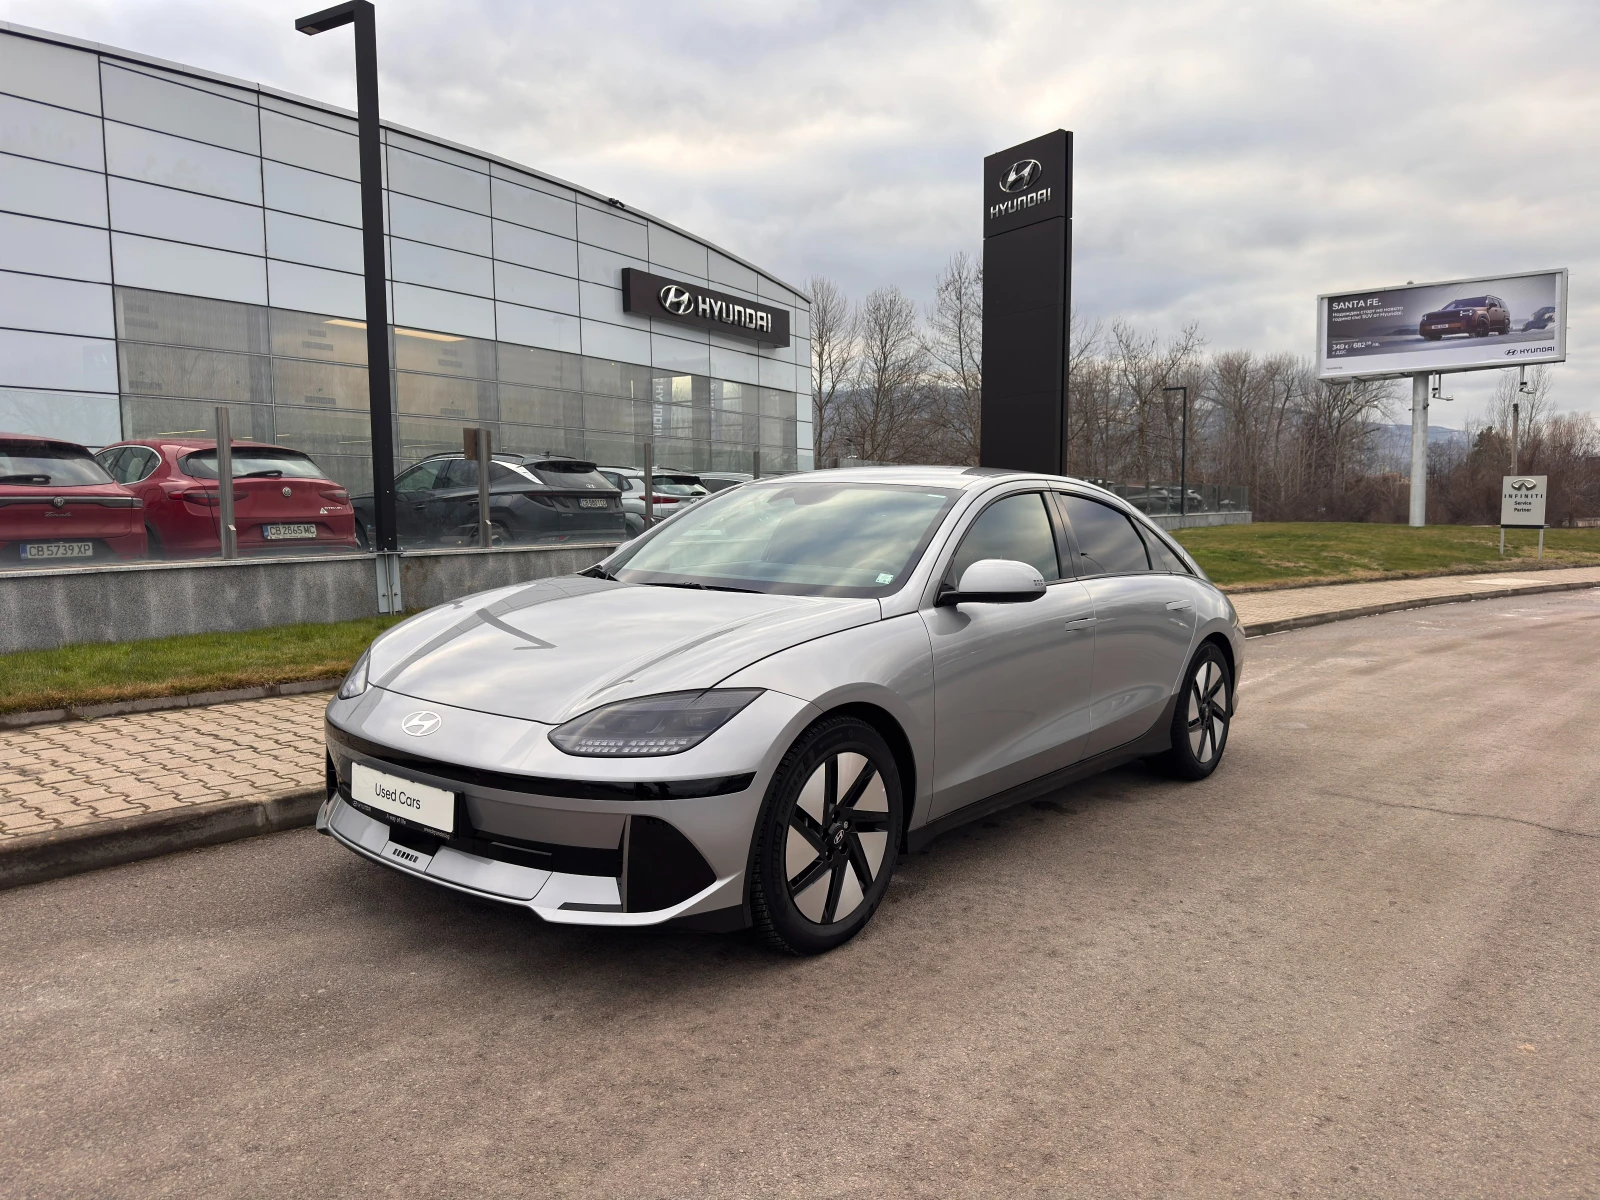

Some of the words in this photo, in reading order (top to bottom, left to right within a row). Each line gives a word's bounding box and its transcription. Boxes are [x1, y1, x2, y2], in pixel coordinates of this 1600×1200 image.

[990, 187, 1051, 220] HYUNDAI
[1332, 300, 1365, 310] SANTA
[1367, 298, 1382, 307] FE.
[697, 295, 772, 333] HYUNDAI
[1519, 346, 1555, 354] HYUNDAI
[269, 526, 281, 535] CB
[282, 525, 303, 535] 2865
[303, 525, 316, 534] MC
[28, 545, 45, 557] CB
[46, 544, 75, 556] 5739
[76, 543, 91, 555] XP
[374, 782, 397, 802] Used
[398, 791, 421, 810] Cars
